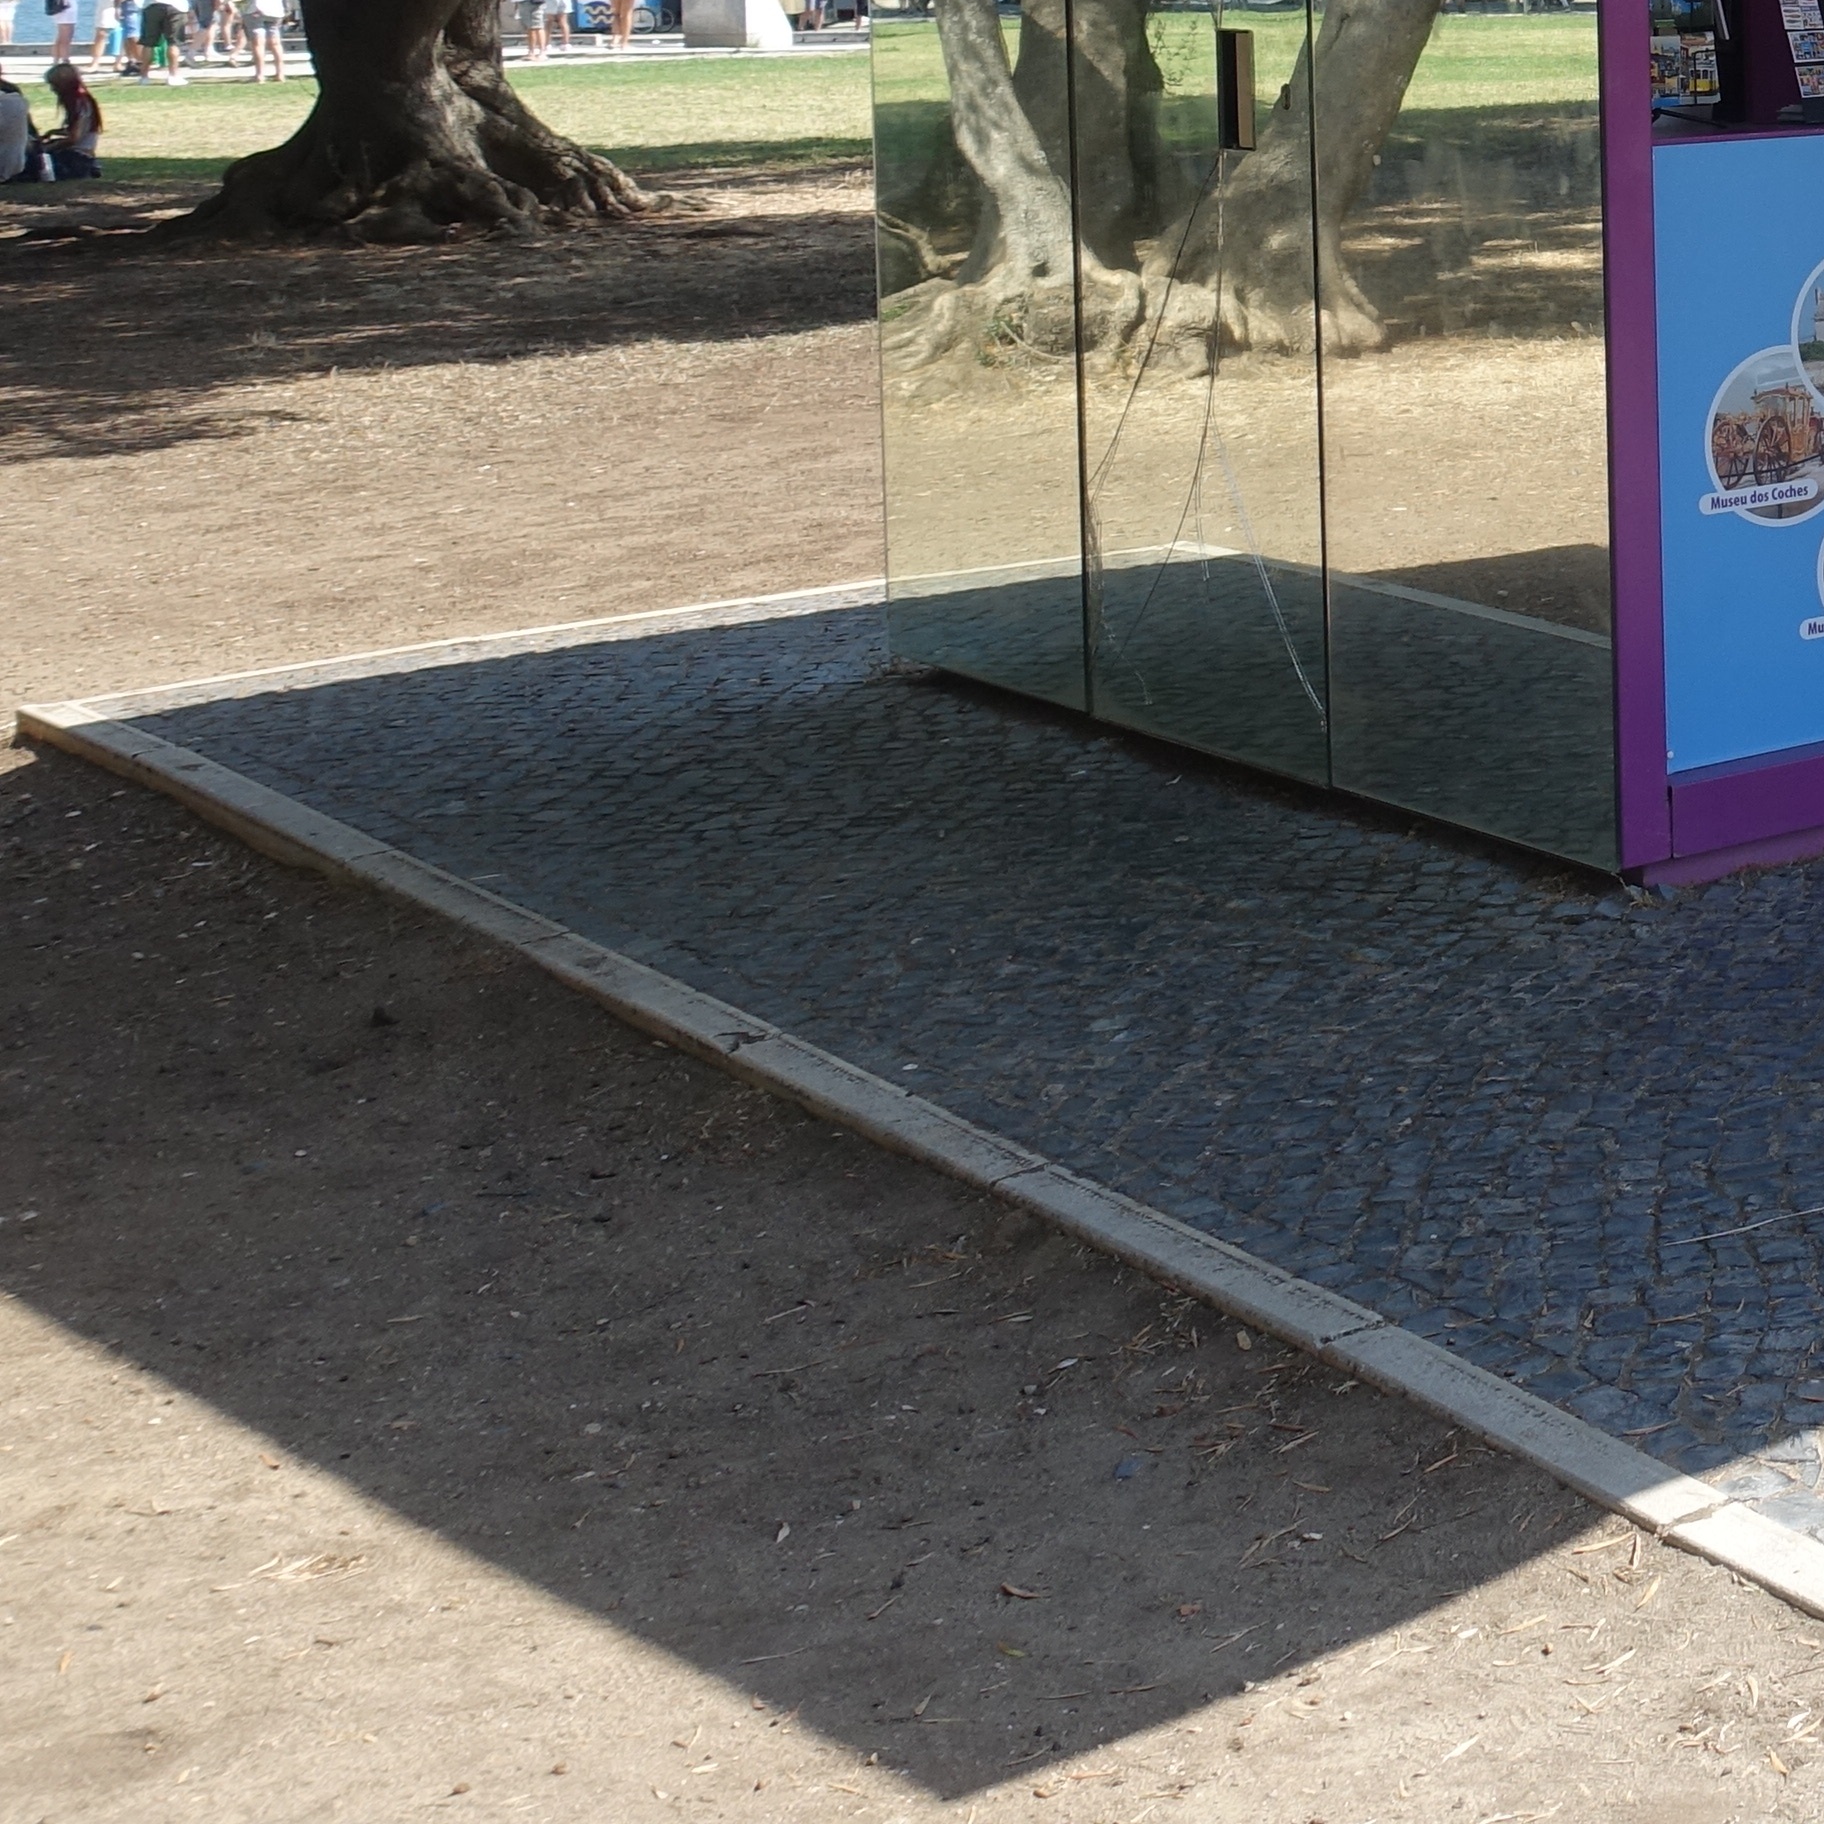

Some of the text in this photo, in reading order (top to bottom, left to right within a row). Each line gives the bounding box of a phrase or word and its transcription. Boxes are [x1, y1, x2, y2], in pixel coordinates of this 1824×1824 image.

[1711, 484, 1809, 511] Museu dos Coches
